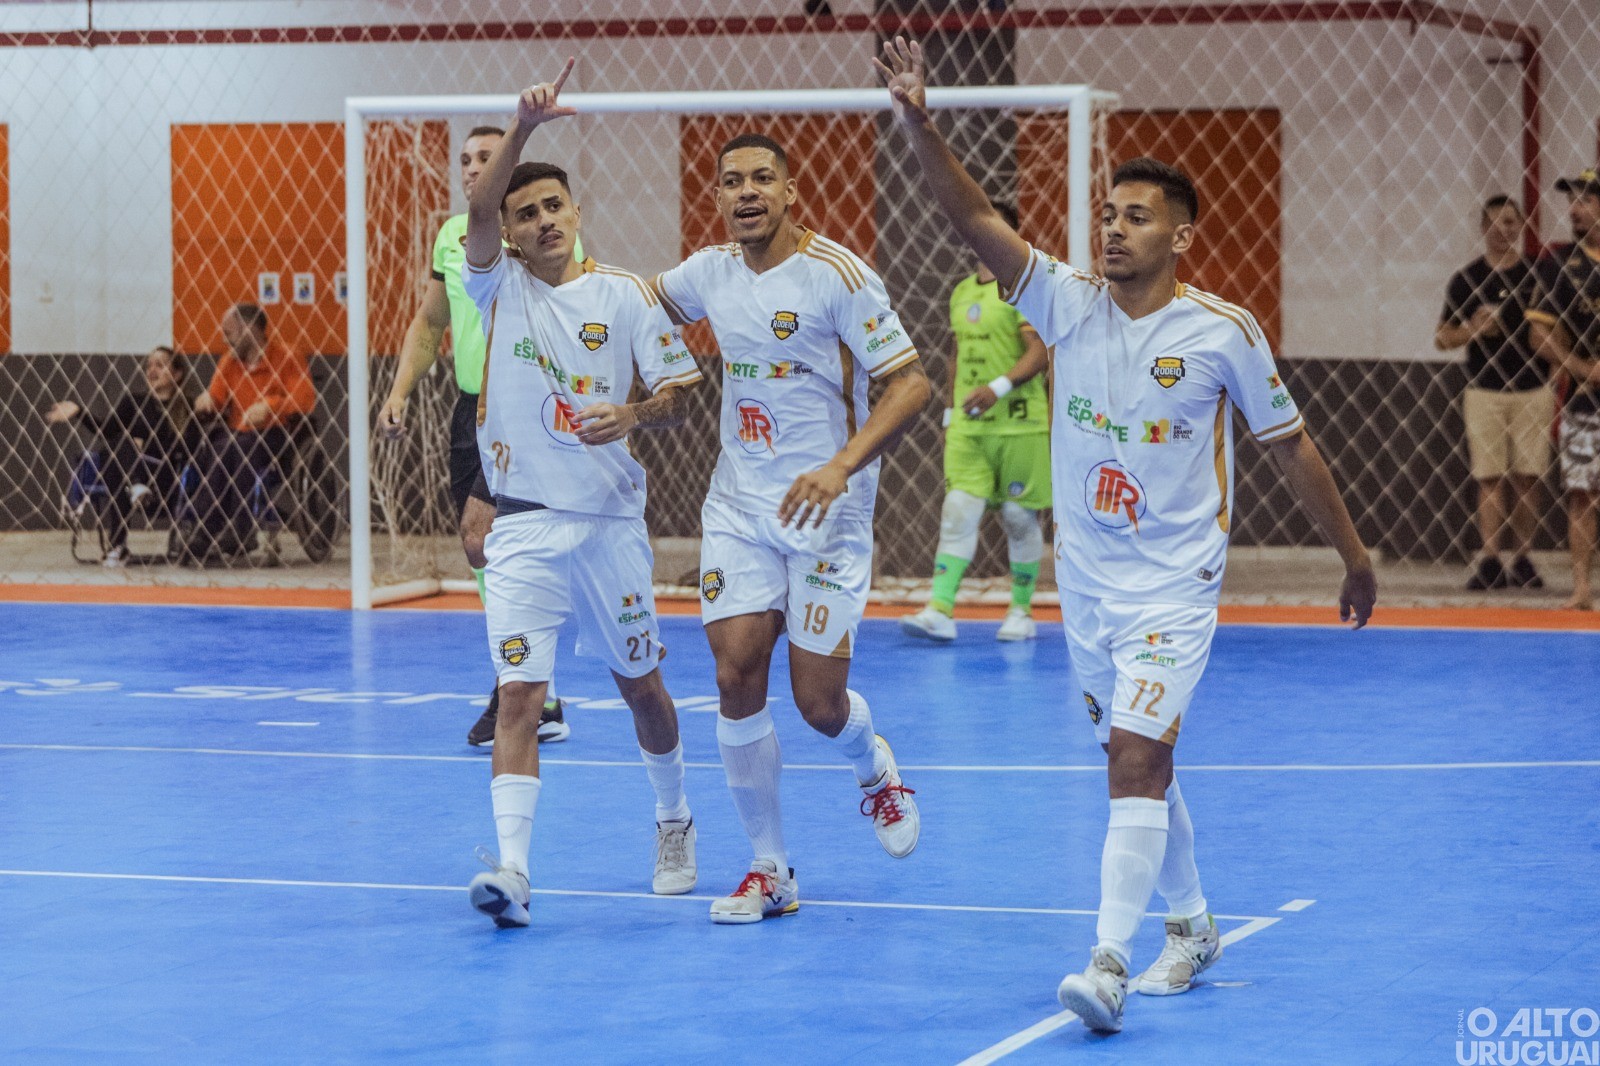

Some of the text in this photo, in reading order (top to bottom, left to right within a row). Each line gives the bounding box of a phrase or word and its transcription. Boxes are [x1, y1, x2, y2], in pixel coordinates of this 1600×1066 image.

[581, 331, 606, 342] RODEIO
[1153, 367, 1182, 378] RODEIO
[803, 601, 829, 635] 19
[626, 629, 650, 662] 27
[1129, 678, 1165, 717] 72
